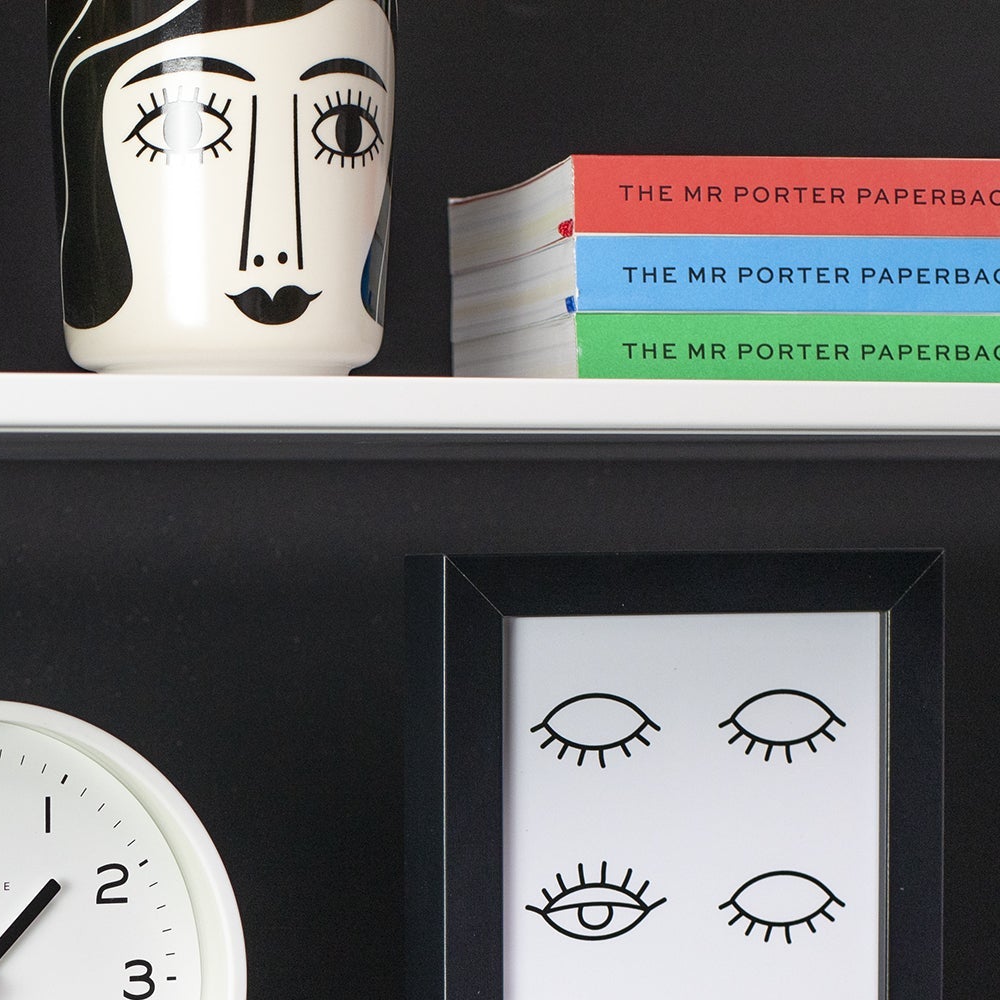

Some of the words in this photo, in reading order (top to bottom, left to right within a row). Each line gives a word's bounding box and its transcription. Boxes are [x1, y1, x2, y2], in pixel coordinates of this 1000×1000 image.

[618, 184, 674, 203] THE
[684, 185, 723, 204] MR
[733, 186, 846, 205] PORTER
[622, 266, 678, 284] THE
[688, 266, 727, 284] MR
[738, 266, 851, 284] PORTER
[622, 342, 678, 360] THE
[688, 342, 727, 361] MR
[737, 343, 851, 361] PORTER
[45, 796, 51, 834] 1
[95, 863, 129, 905] 2
[122, 959, 156, 1000] 3
